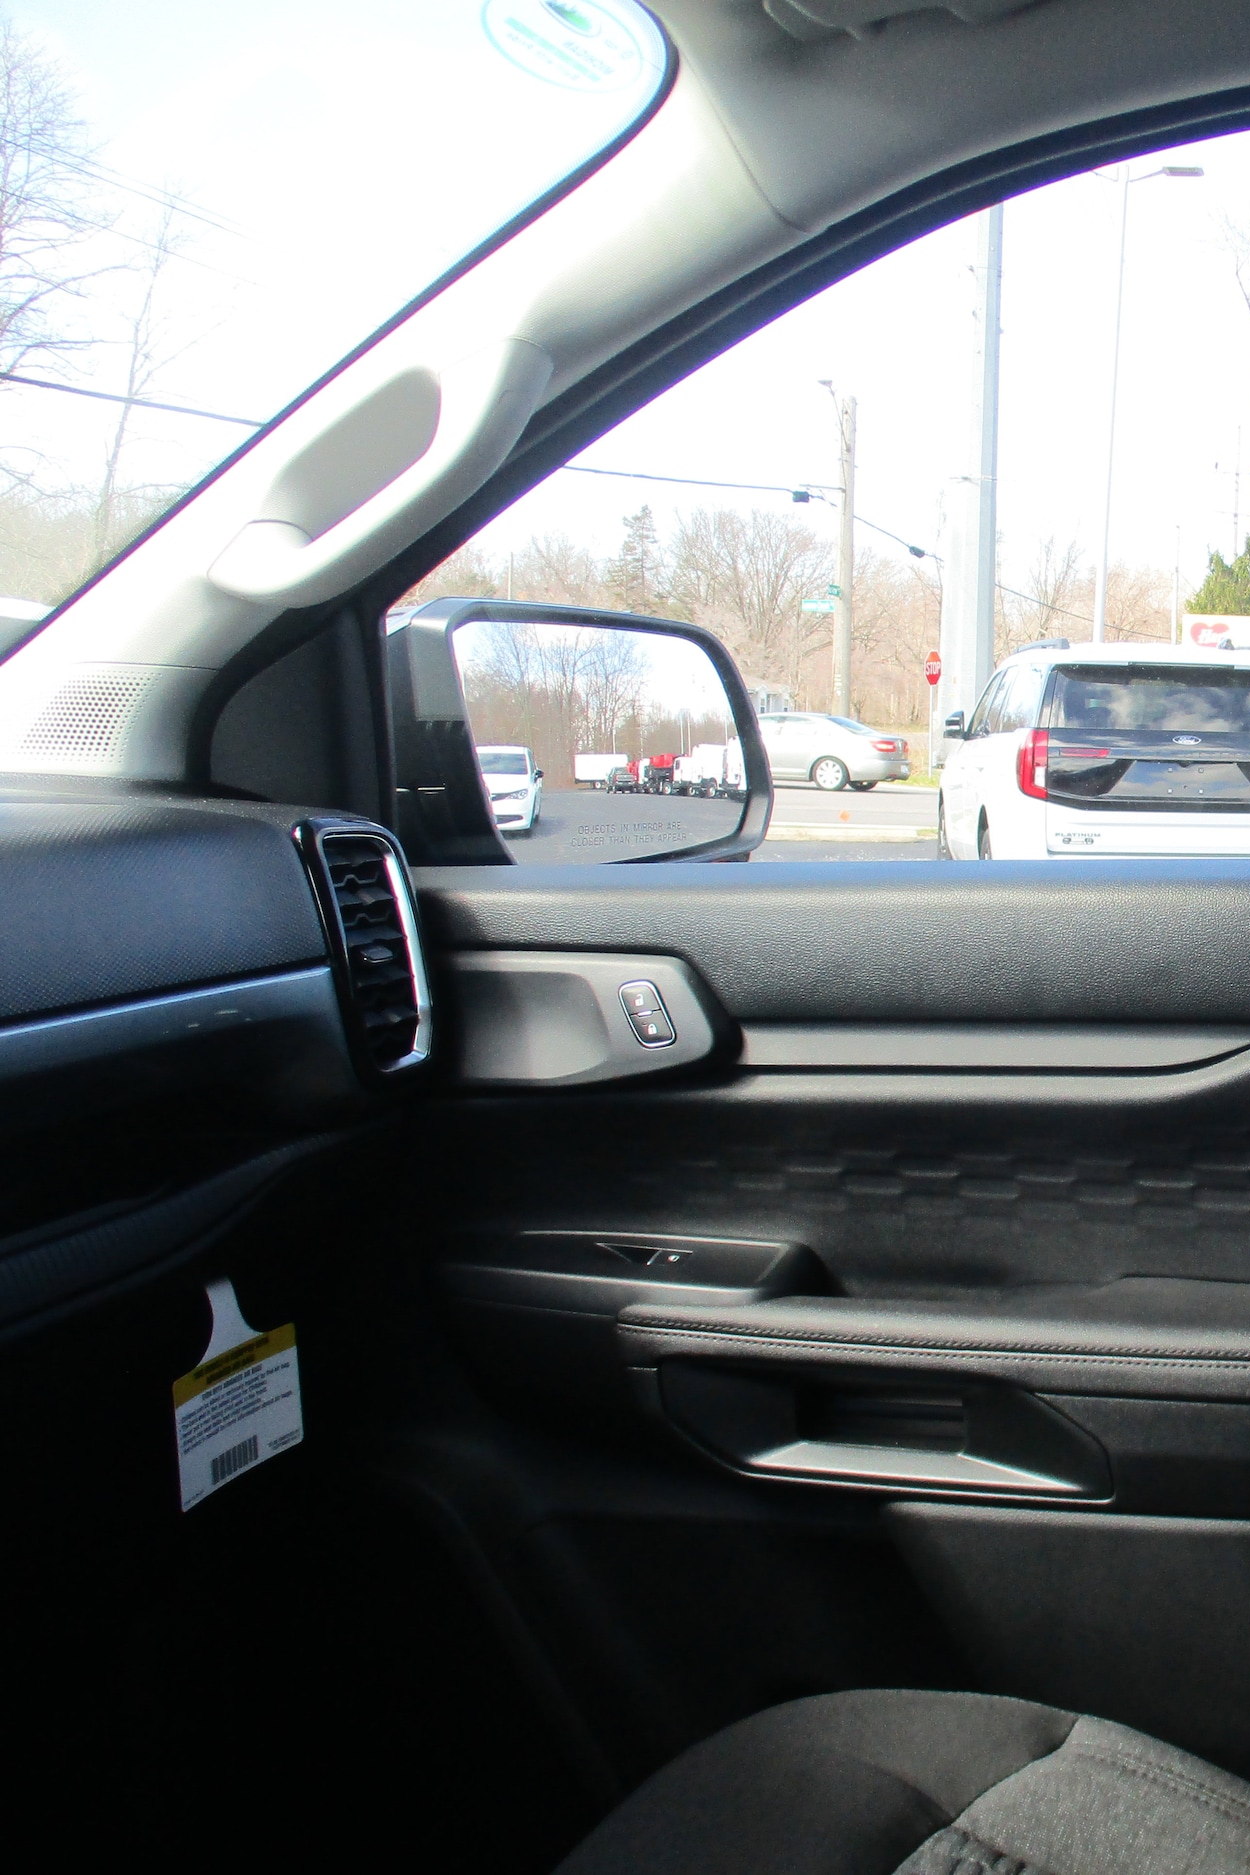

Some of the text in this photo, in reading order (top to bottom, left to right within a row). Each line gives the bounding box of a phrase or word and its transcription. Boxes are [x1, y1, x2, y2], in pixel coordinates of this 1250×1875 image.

[926, 661, 941, 676] STOP
[577, 821, 681, 835] OBJECTS IN MIRROR ARE
[571, 833, 687, 847] CLOSER THAN THEY APPEAR
